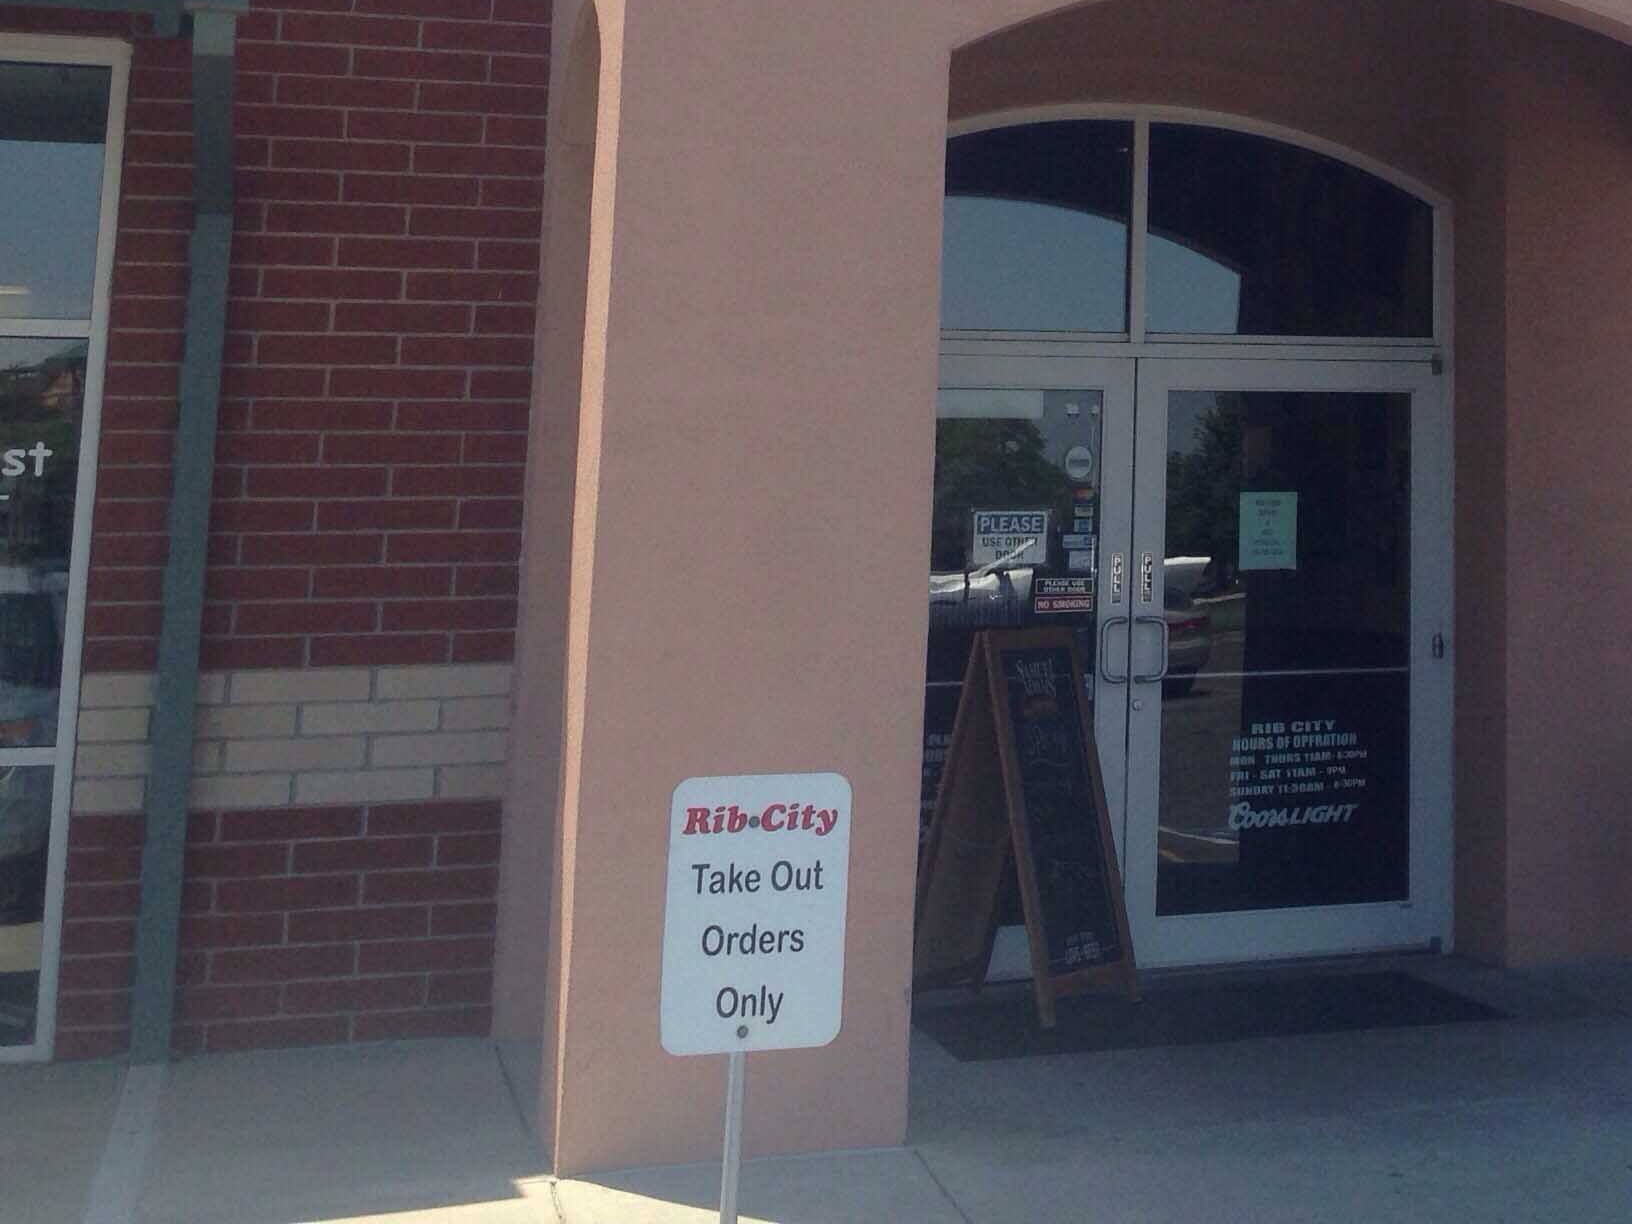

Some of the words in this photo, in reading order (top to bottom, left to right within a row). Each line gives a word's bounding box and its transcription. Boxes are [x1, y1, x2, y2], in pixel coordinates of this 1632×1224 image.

[980, 516, 1041, 533] PLEASE
[982, 537, 1002, 548] USE
[1113, 557, 1122, 593] PULL
[1143, 556, 1152, 591] PULL
[1037, 600, 1050, 609] NO
[1052, 599, 1090, 608] SMOKING
[1251, 722, 1285, 735] RIB
[1291, 720, 1336, 733] CITY
[1232, 736, 1273, 752] HOURS
[1293, 732, 1358, 749] OPERATION
[682, 805, 749, 835] Rib
[760, 803, 839, 836] City
[1290, 805, 1359, 825] LIGHT
[692, 863, 760, 894] Take
[771, 860, 823, 891] Out
[702, 923, 804, 956] Orders
[716, 985, 783, 1024] Only
